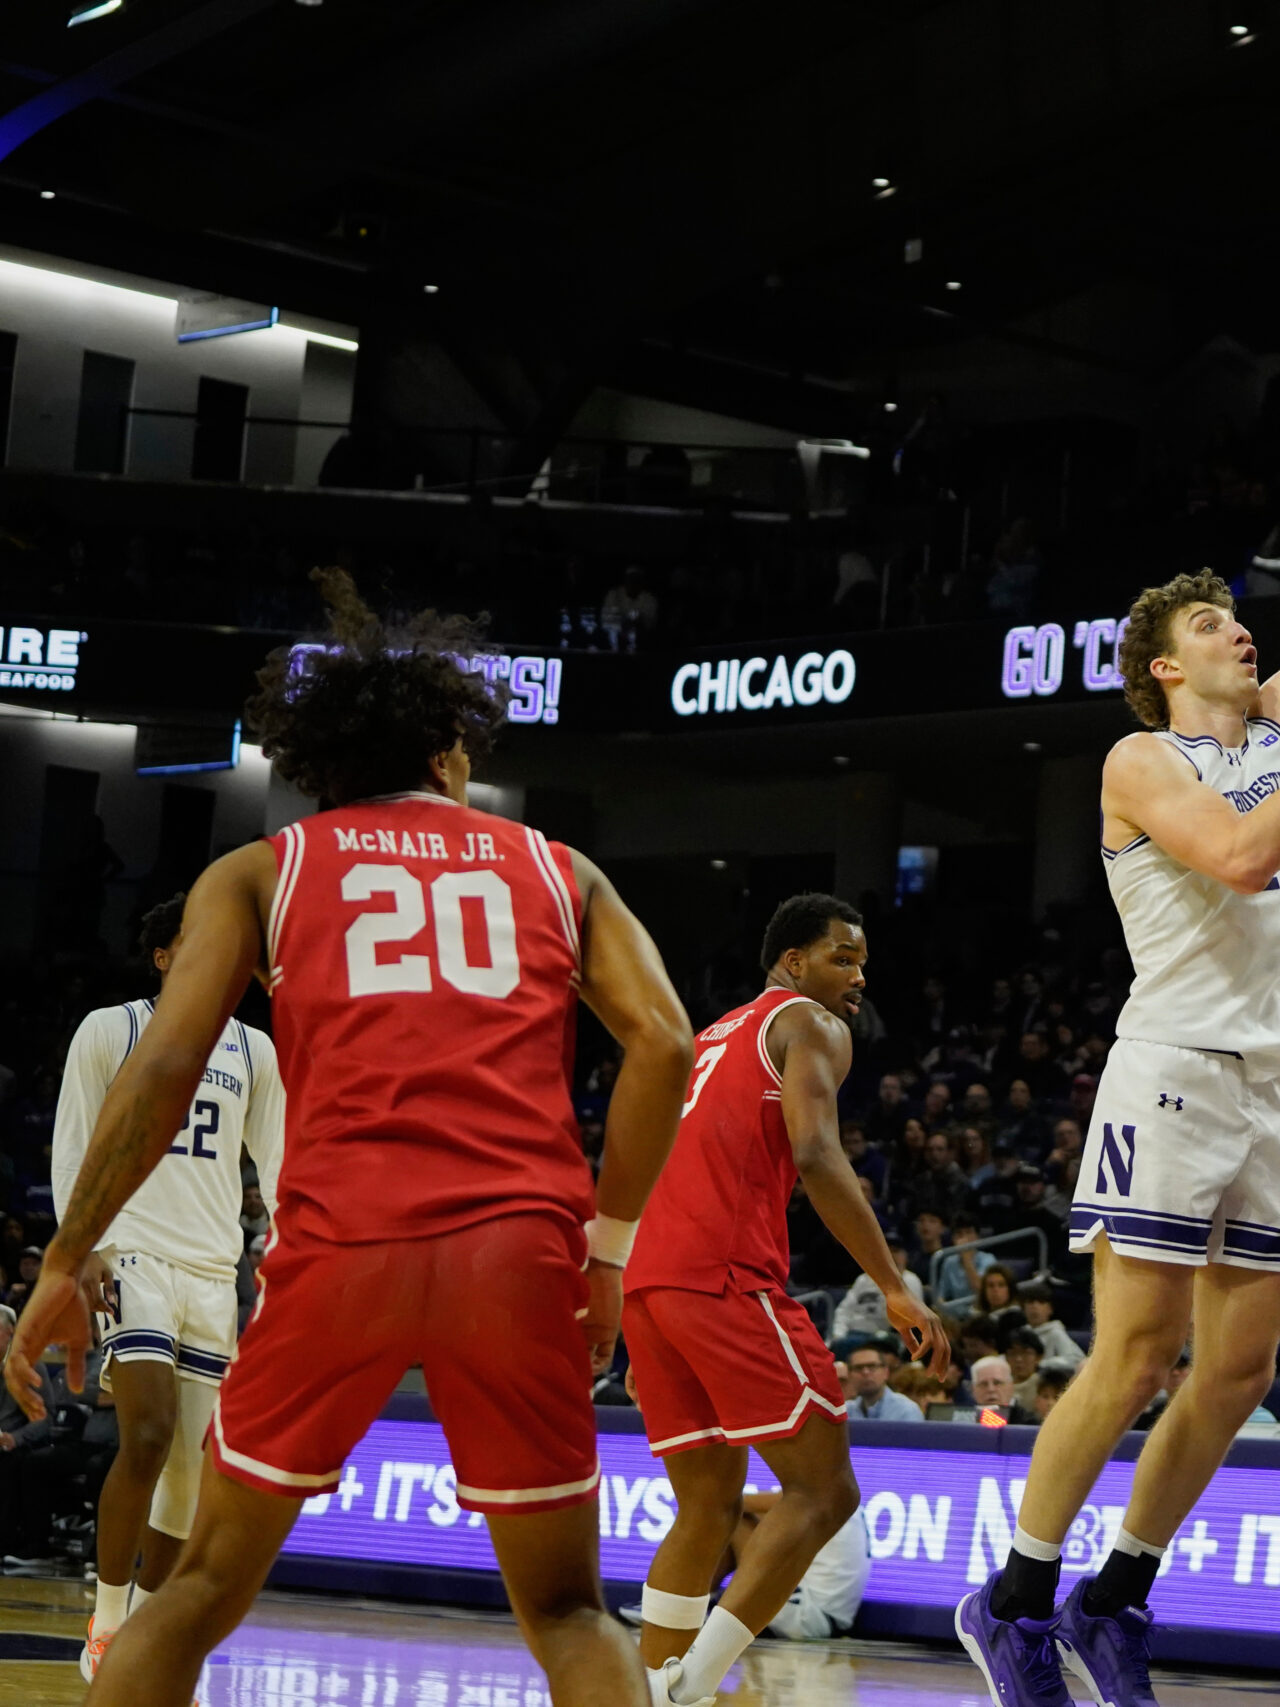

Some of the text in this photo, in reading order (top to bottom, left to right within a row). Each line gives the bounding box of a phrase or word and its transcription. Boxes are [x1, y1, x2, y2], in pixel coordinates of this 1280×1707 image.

[670, 649, 857, 717] CHICAGO
[1002, 622, 1066, 698] GO
[460, 832, 506, 862] JR.
[340, 863, 521, 999] 20
[201, 1067, 243, 1099] STERN
[1095, 1122, 1137, 1198] N
[862, 1491, 953, 1562] ON
